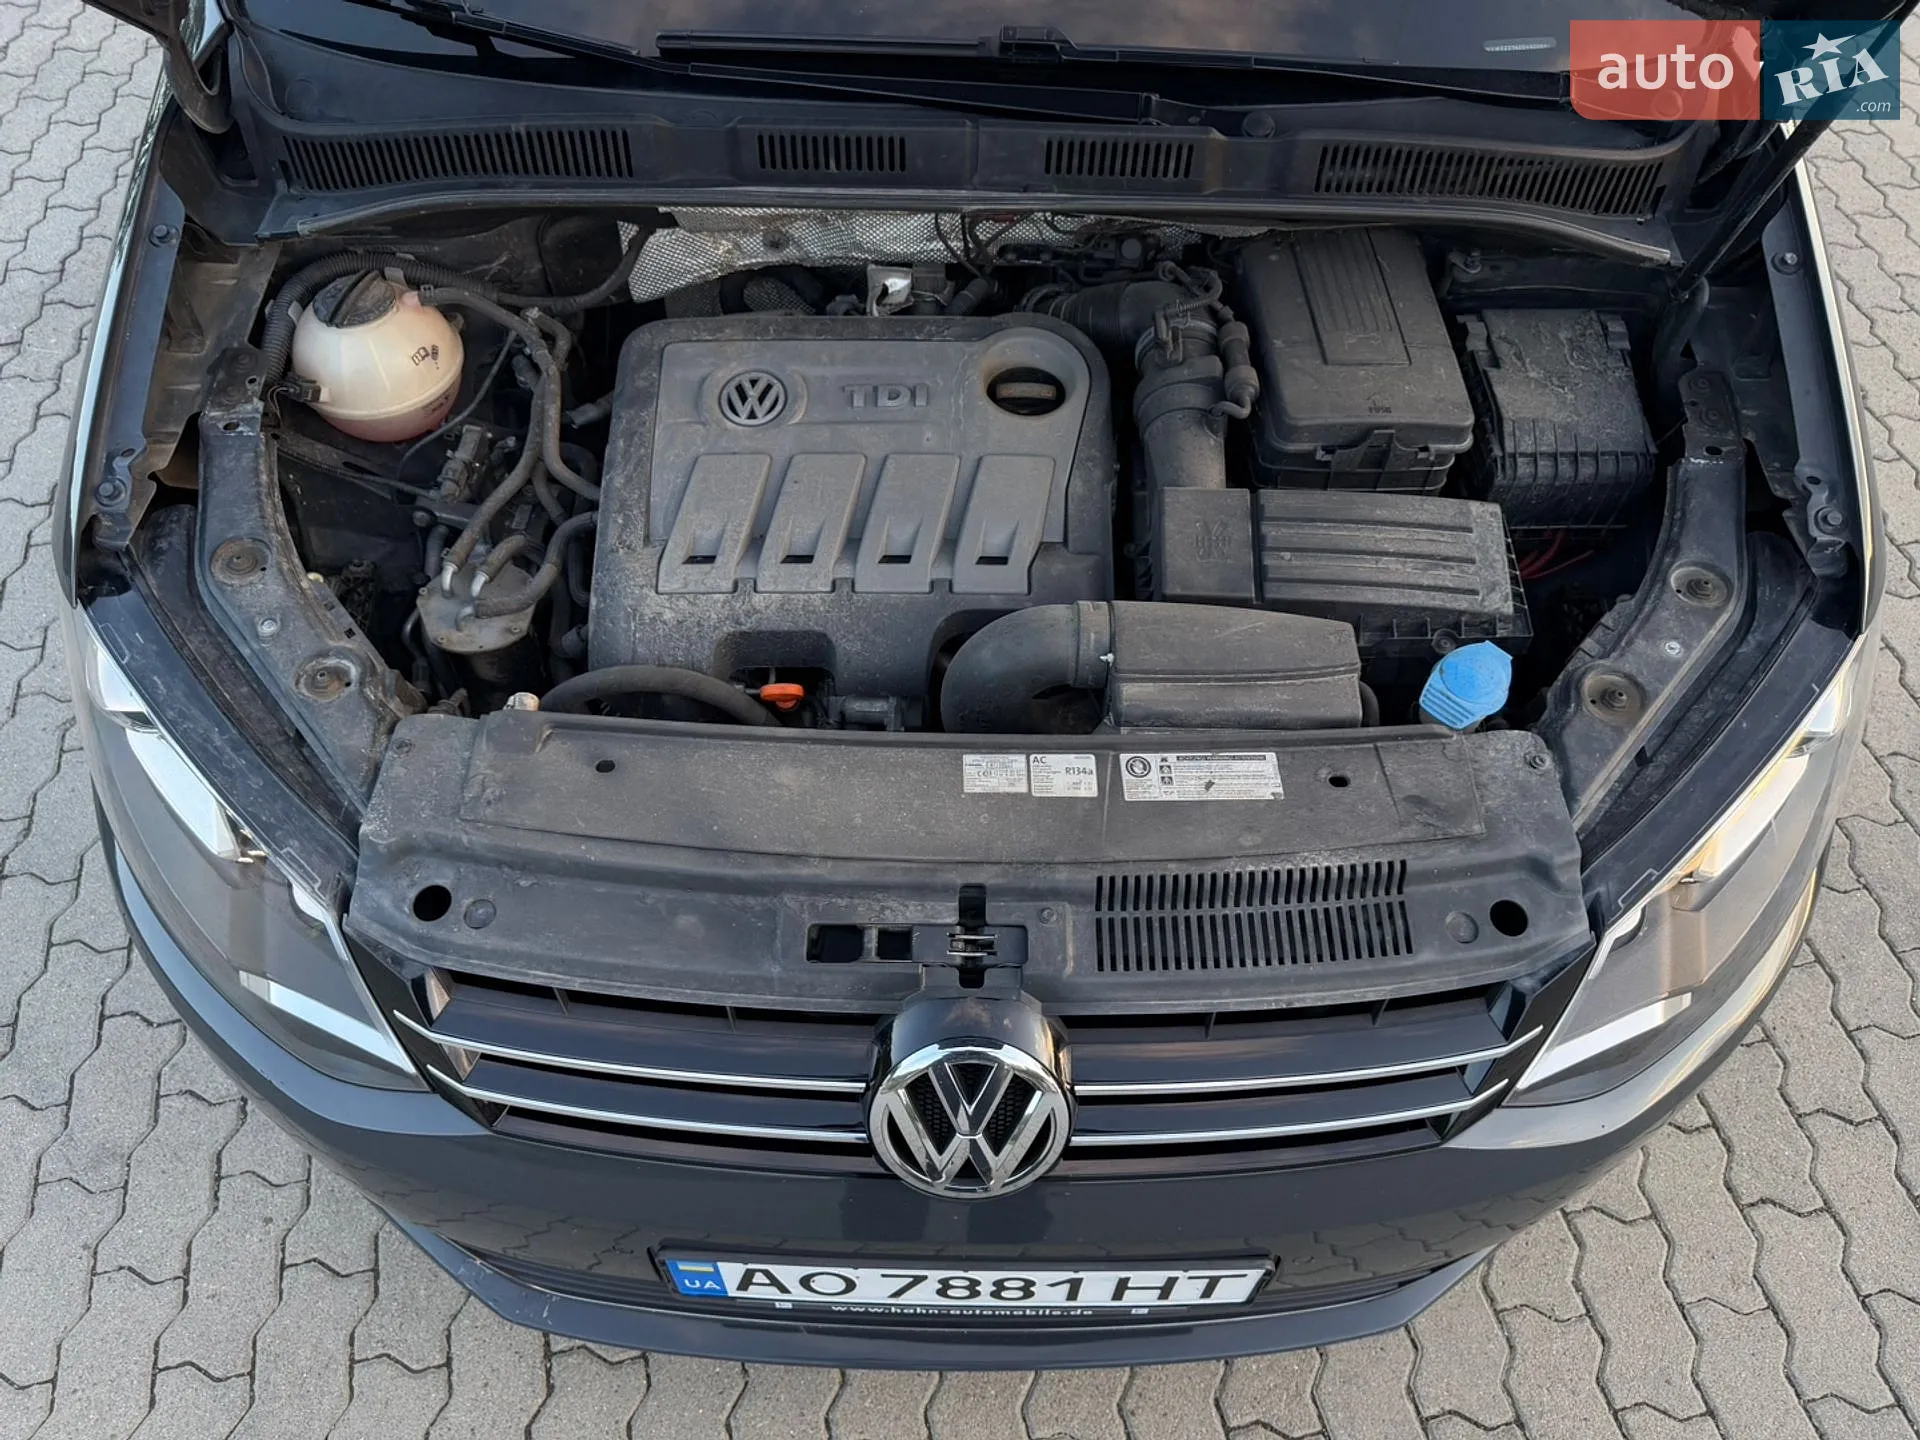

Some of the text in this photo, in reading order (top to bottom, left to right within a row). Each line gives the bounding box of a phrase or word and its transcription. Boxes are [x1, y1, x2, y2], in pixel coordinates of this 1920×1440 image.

[843, 384, 930, 409] TDI
[1032, 756, 1047, 764] AC
[1065, 766, 1094, 776] R134a
[684, 1278, 721, 1290] UA
[736, 1268, 1248, 1302] AO 7881 HT
[831, 1304, 1094, 1316] www.hahn-automobile.de
